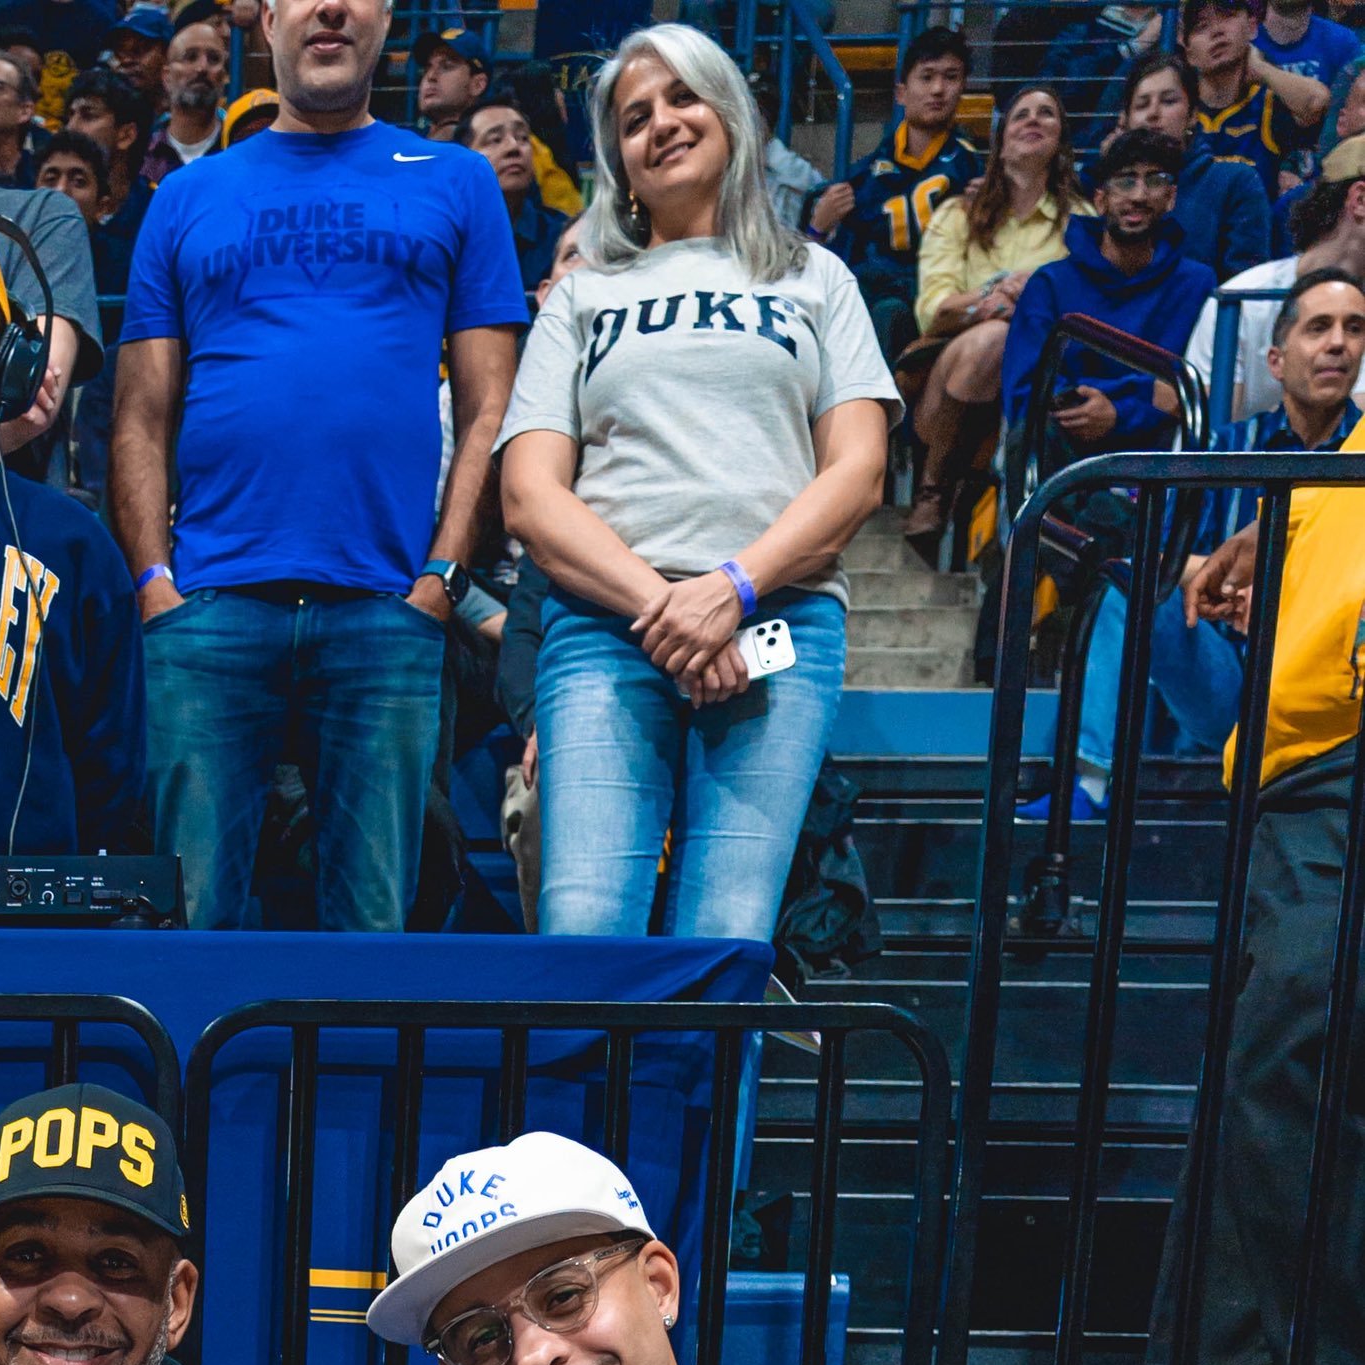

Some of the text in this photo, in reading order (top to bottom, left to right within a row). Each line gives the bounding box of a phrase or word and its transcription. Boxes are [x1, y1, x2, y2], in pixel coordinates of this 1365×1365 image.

[258, 202, 364, 234] DUKE
[200, 229, 426, 286] UNIVERSITY
[585, 290, 797, 387] DUKE
[423, 1170, 506, 1229] DUKE
